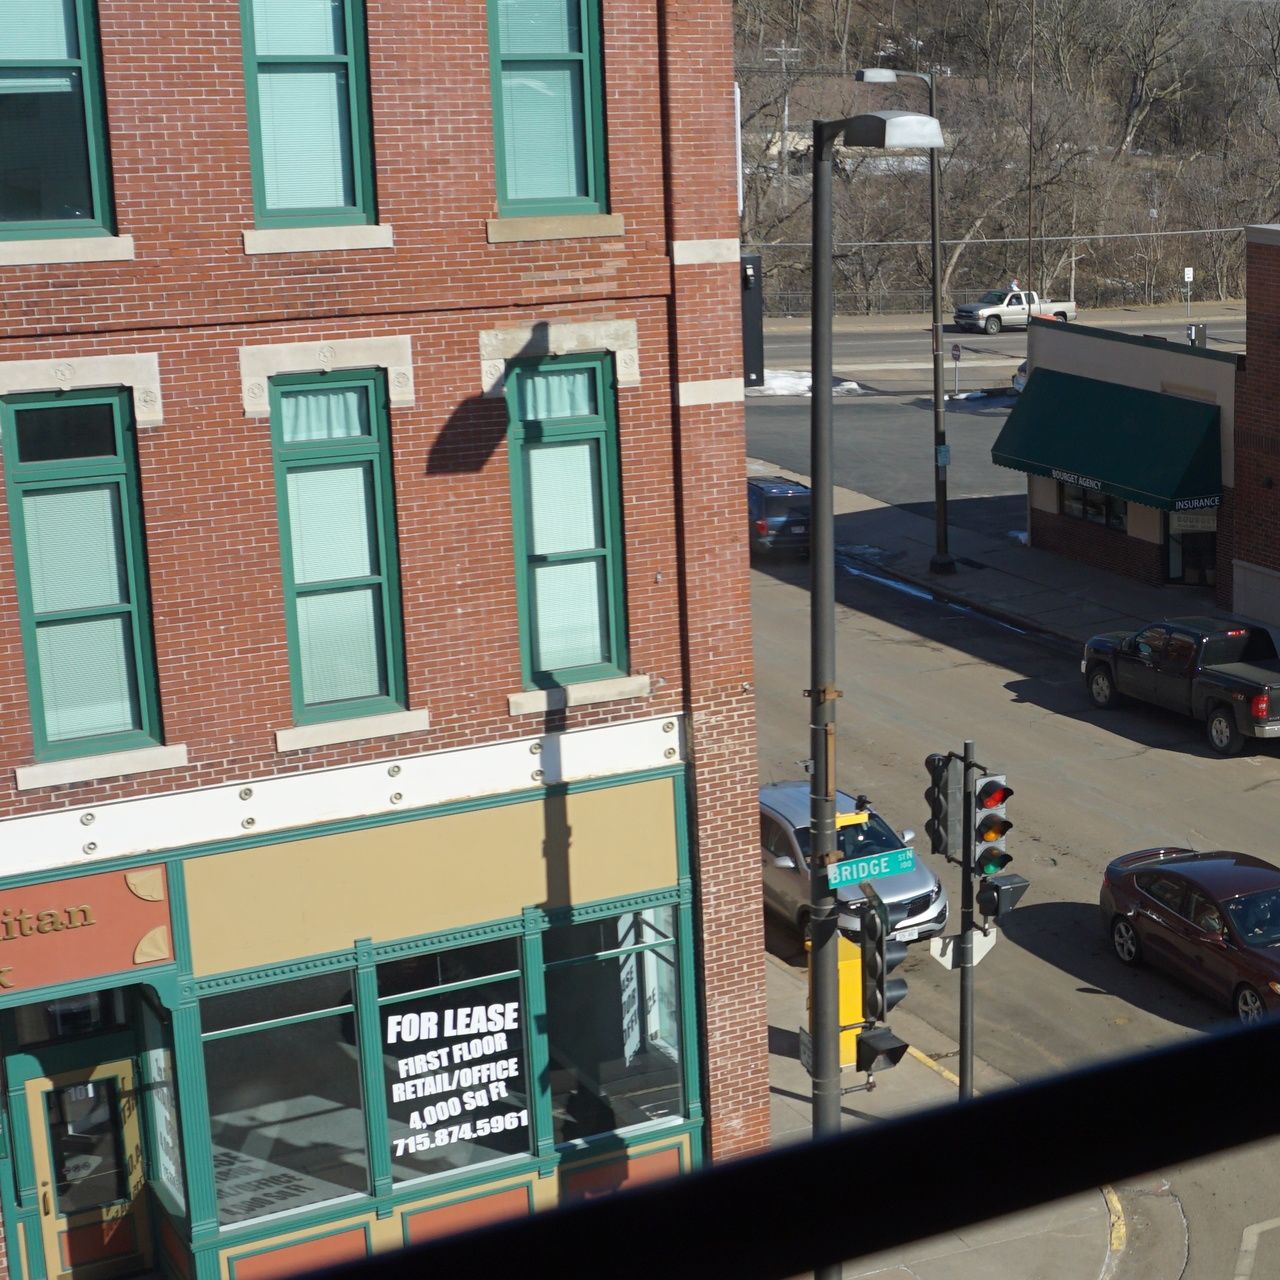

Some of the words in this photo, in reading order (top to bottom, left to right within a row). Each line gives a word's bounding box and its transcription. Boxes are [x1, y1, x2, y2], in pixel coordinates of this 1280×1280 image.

[1051, 469, 1078, 484] BOURGET
[1078, 476, 1102, 490] AGENCY
[1175, 496, 1220, 510] INSURANCE
[830, 857, 890, 884] BRIDGE
[0, 904, 96, 941] itan
[386, 1011, 438, 1044] FOR
[444, 1002, 519, 1038] LEASE
[397, 1047, 450, 1079] FIRST
[452, 1032, 508, 1064] FLOOR
[392, 1057, 519, 1103] RETAIL/OFFICE
[409, 1096, 461, 1131] 4,000
[463, 1089, 489, 1111] Sq
[489, 1081, 508, 1103] Ft
[393, 1109, 529, 1157] 715.874.5961
